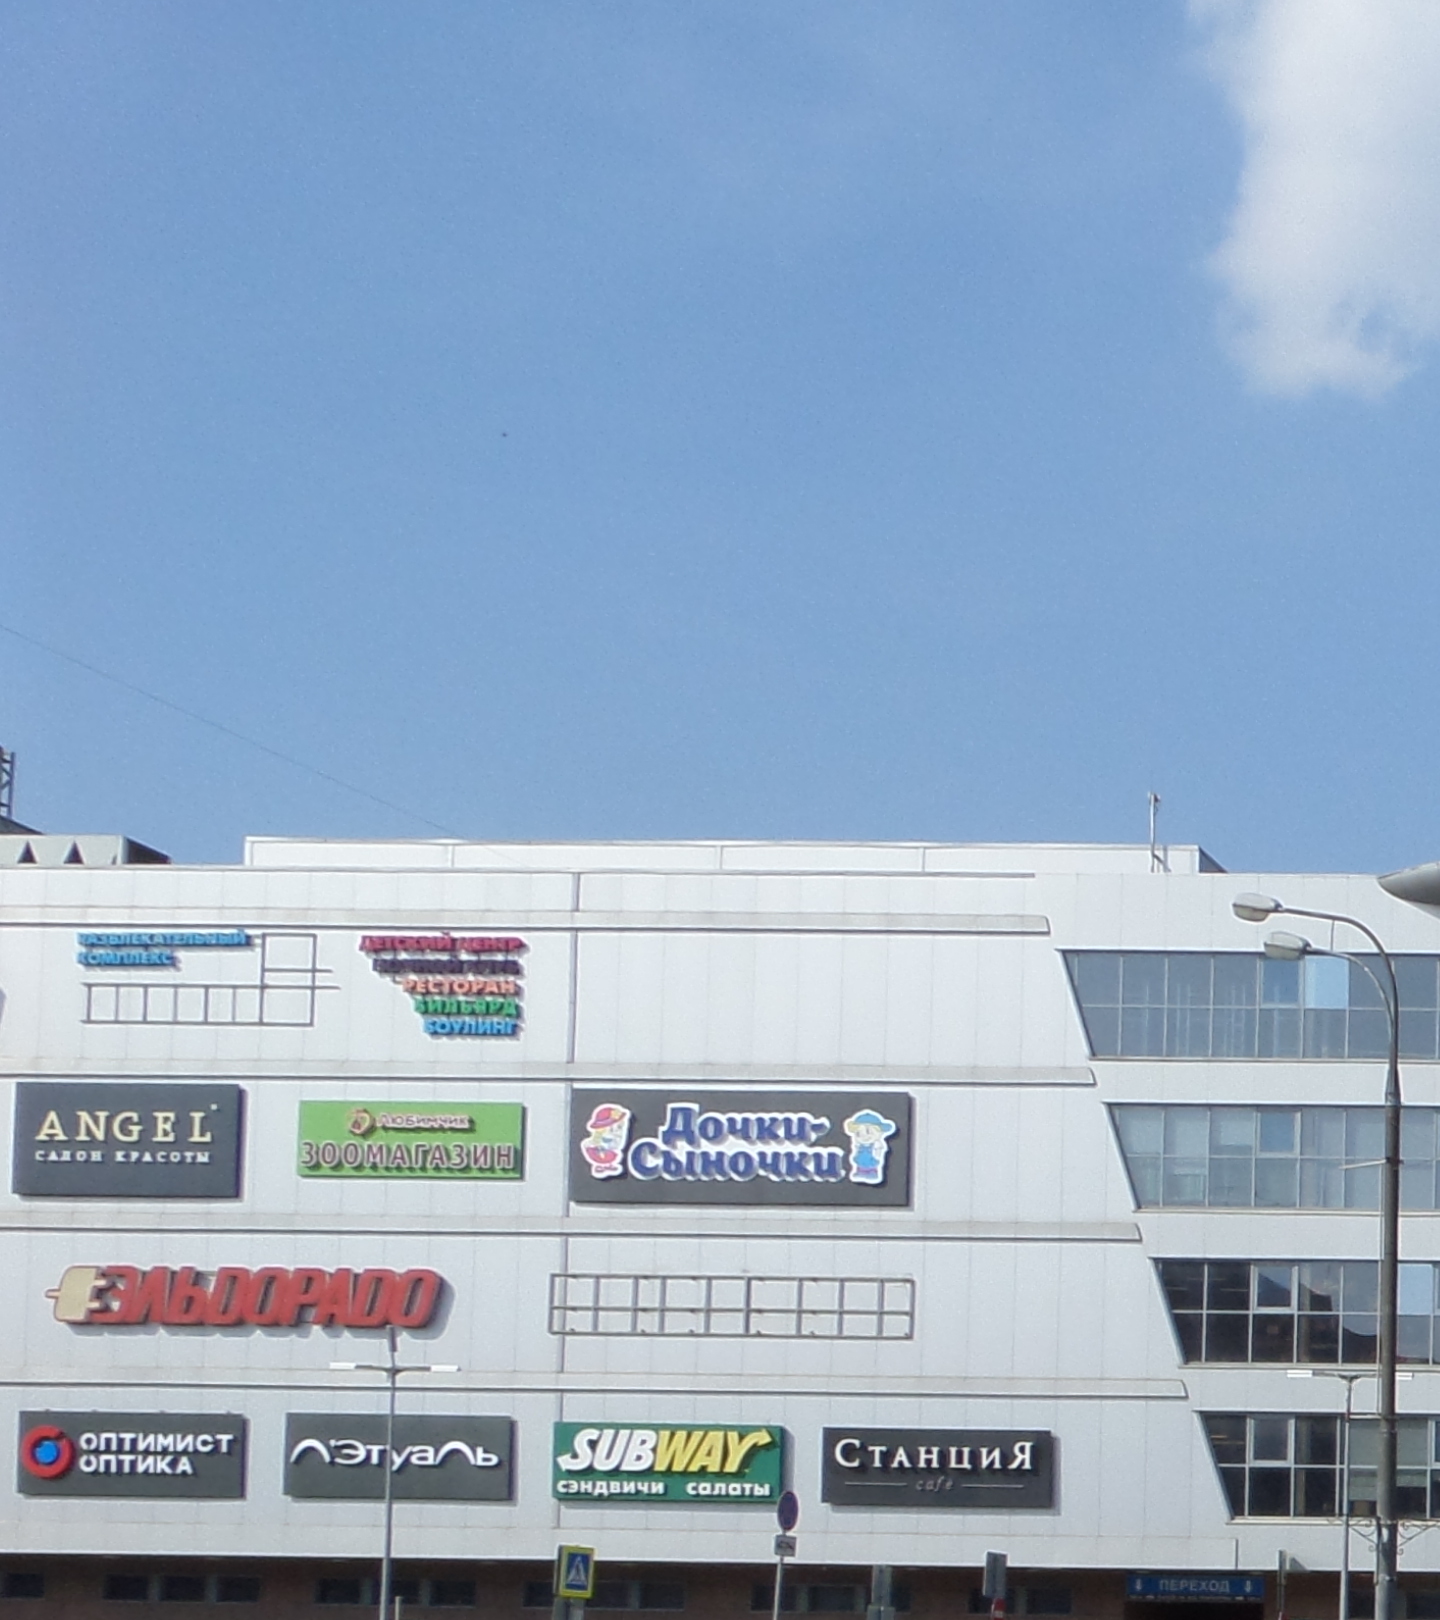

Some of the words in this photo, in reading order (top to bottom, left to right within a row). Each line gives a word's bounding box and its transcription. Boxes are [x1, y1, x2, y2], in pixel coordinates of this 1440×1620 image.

[77, 952, 177, 967] КОМПЛЕКС
[402, 979, 516, 995] РЕСТОРАН
[414, 998, 518, 1016] БИЛЬЯРД
[423, 1017, 516, 1036] БОУЛИНГ
[34, 1110, 212, 1143] ANGEL
[34, 1150, 103, 1162] САЛОН
[115, 1151, 210, 1163] КРАСОТЫ
[300, 1141, 515, 1169] ЗООМАГАЗИН
[628, 1140, 844, 1180] Сыночки
[79, 1432, 234, 1453] ОПТИМИСТ
[556, 1428, 773, 1473] SUBWAY
[79, 1454, 194, 1475] ОПТИКА
[556, 1480, 665, 1496] сэндвичи
[686, 1481, 771, 1497] салаты
[1159, 1580, 1230, 1594] ПЕРЕХОД
